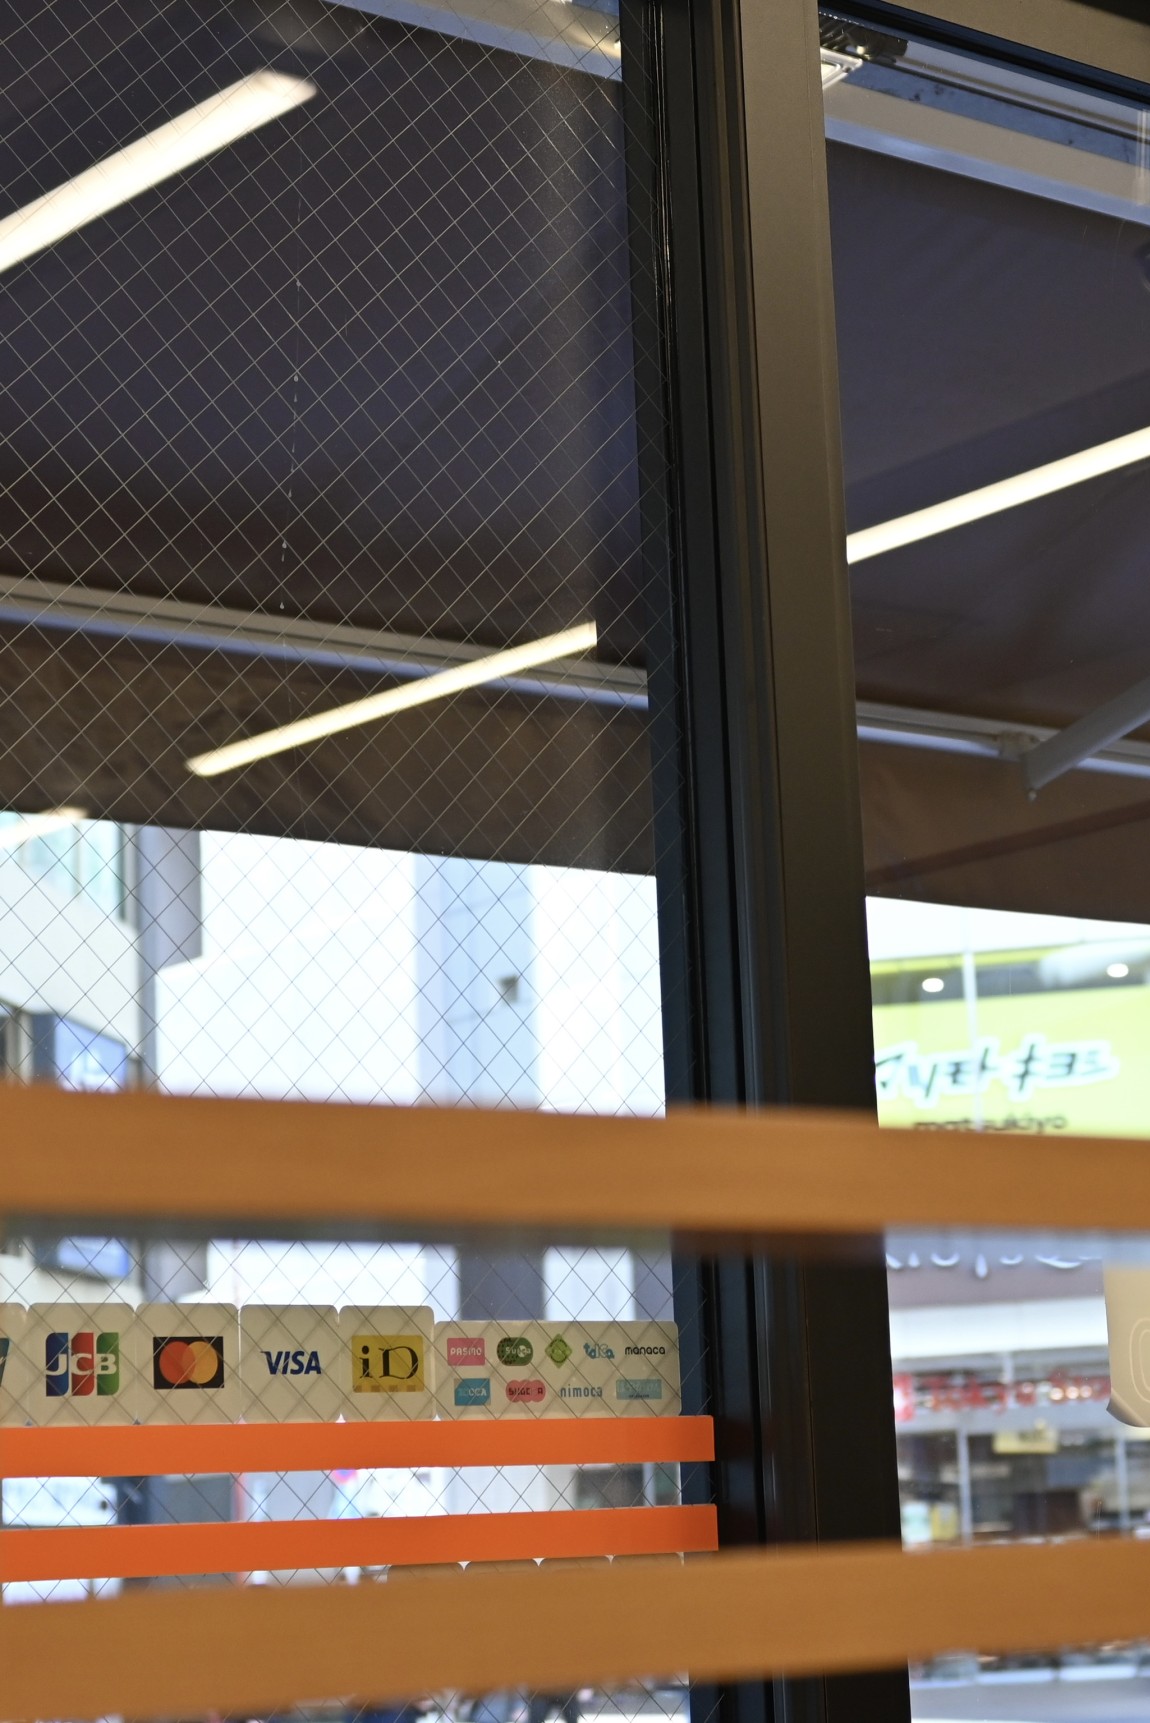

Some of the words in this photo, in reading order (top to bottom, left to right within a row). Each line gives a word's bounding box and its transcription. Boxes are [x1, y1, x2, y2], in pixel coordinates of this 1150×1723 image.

[450, 1346, 482, 1356] PASMO
[624, 1346, 666, 1356] manaca
[260, 1350, 321, 1375] VISA
[360, 1345, 419, 1379] iD
[560, 1384, 603, 1398] nimoca
